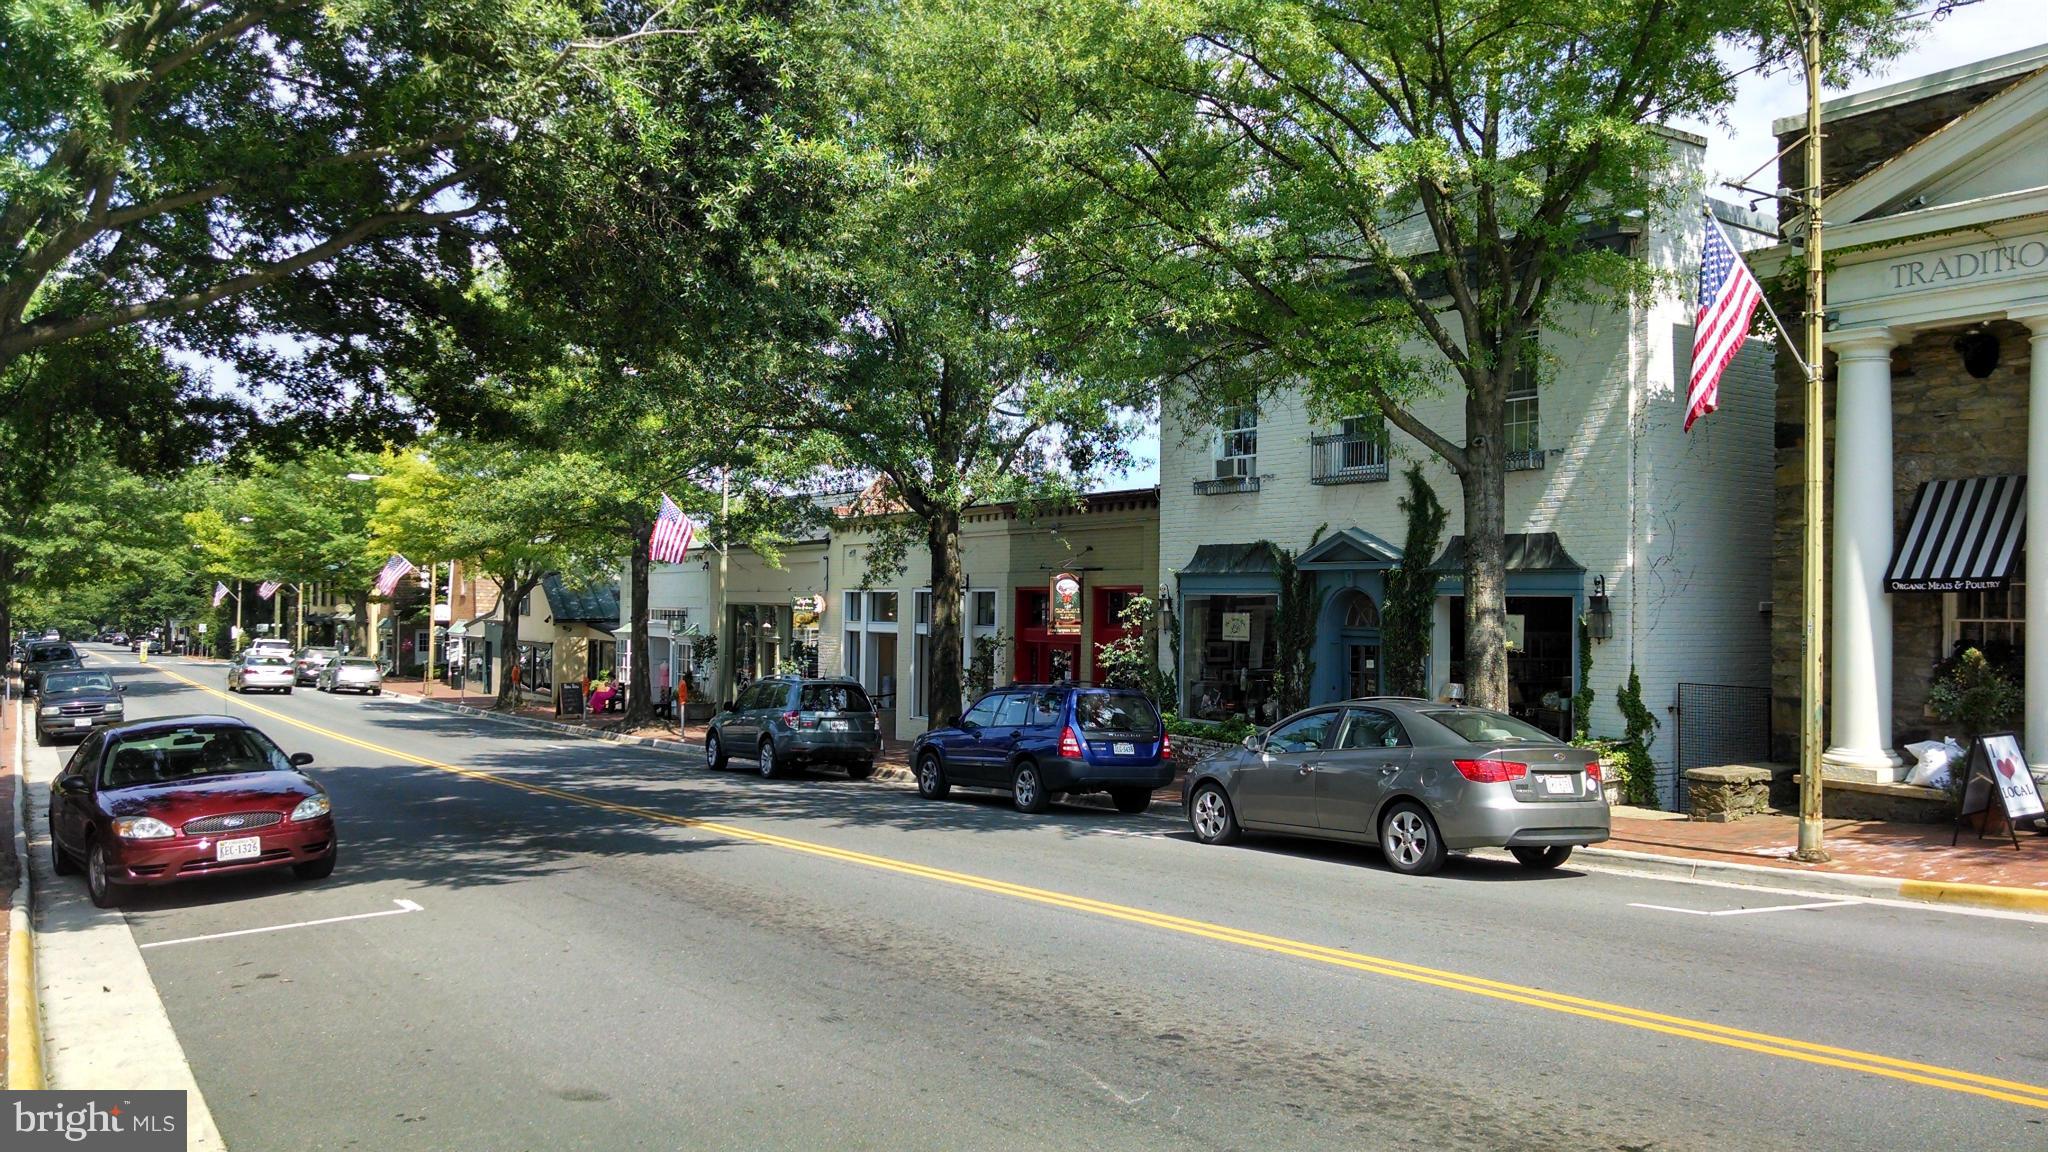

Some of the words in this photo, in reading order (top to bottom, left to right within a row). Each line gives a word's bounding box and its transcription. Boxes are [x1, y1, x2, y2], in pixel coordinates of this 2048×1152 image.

[1890, 241, 2048, 288] TRADITIO
[1954, 581, 1964, 589] &
[2002, 783, 2033, 798] LOCAL
[220, 843, 257, 858] KEC-1326
